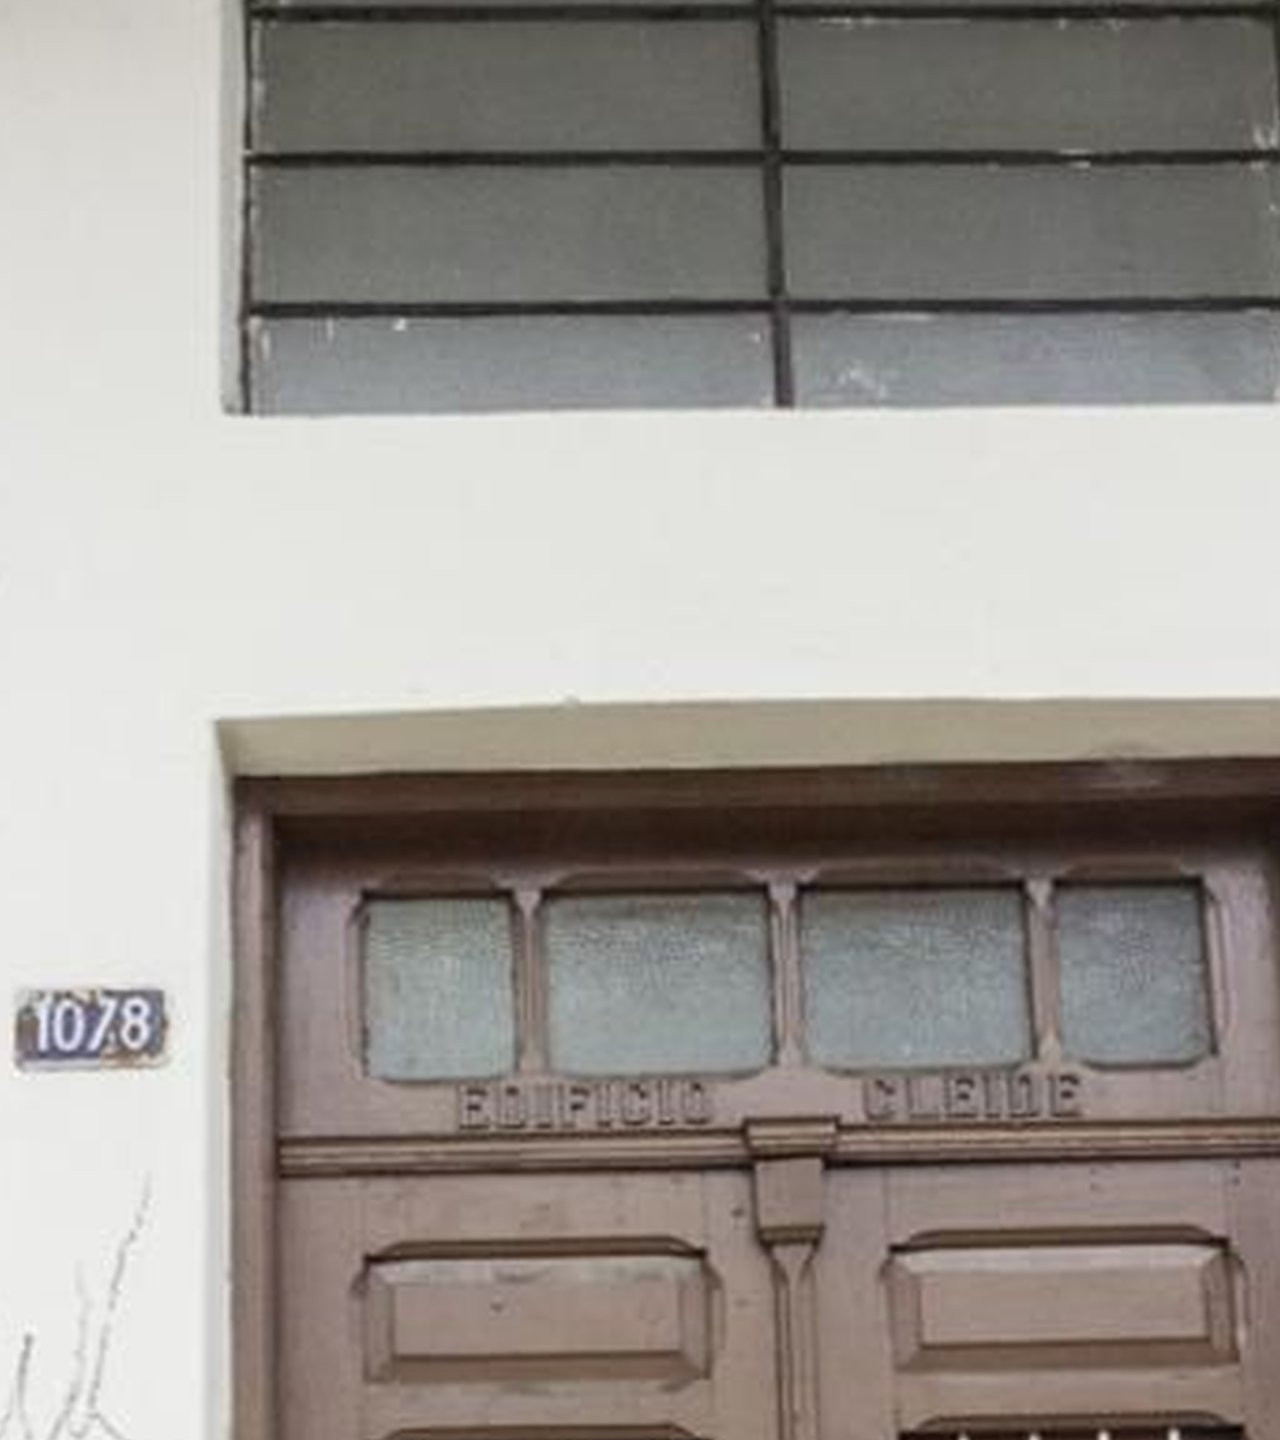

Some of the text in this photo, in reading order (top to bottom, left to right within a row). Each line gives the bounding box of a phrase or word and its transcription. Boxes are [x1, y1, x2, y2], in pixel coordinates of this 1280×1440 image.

[36, 998, 151, 1052] 1078
[458, 1073, 1083, 1130] EDIFICIO CLEIDE
